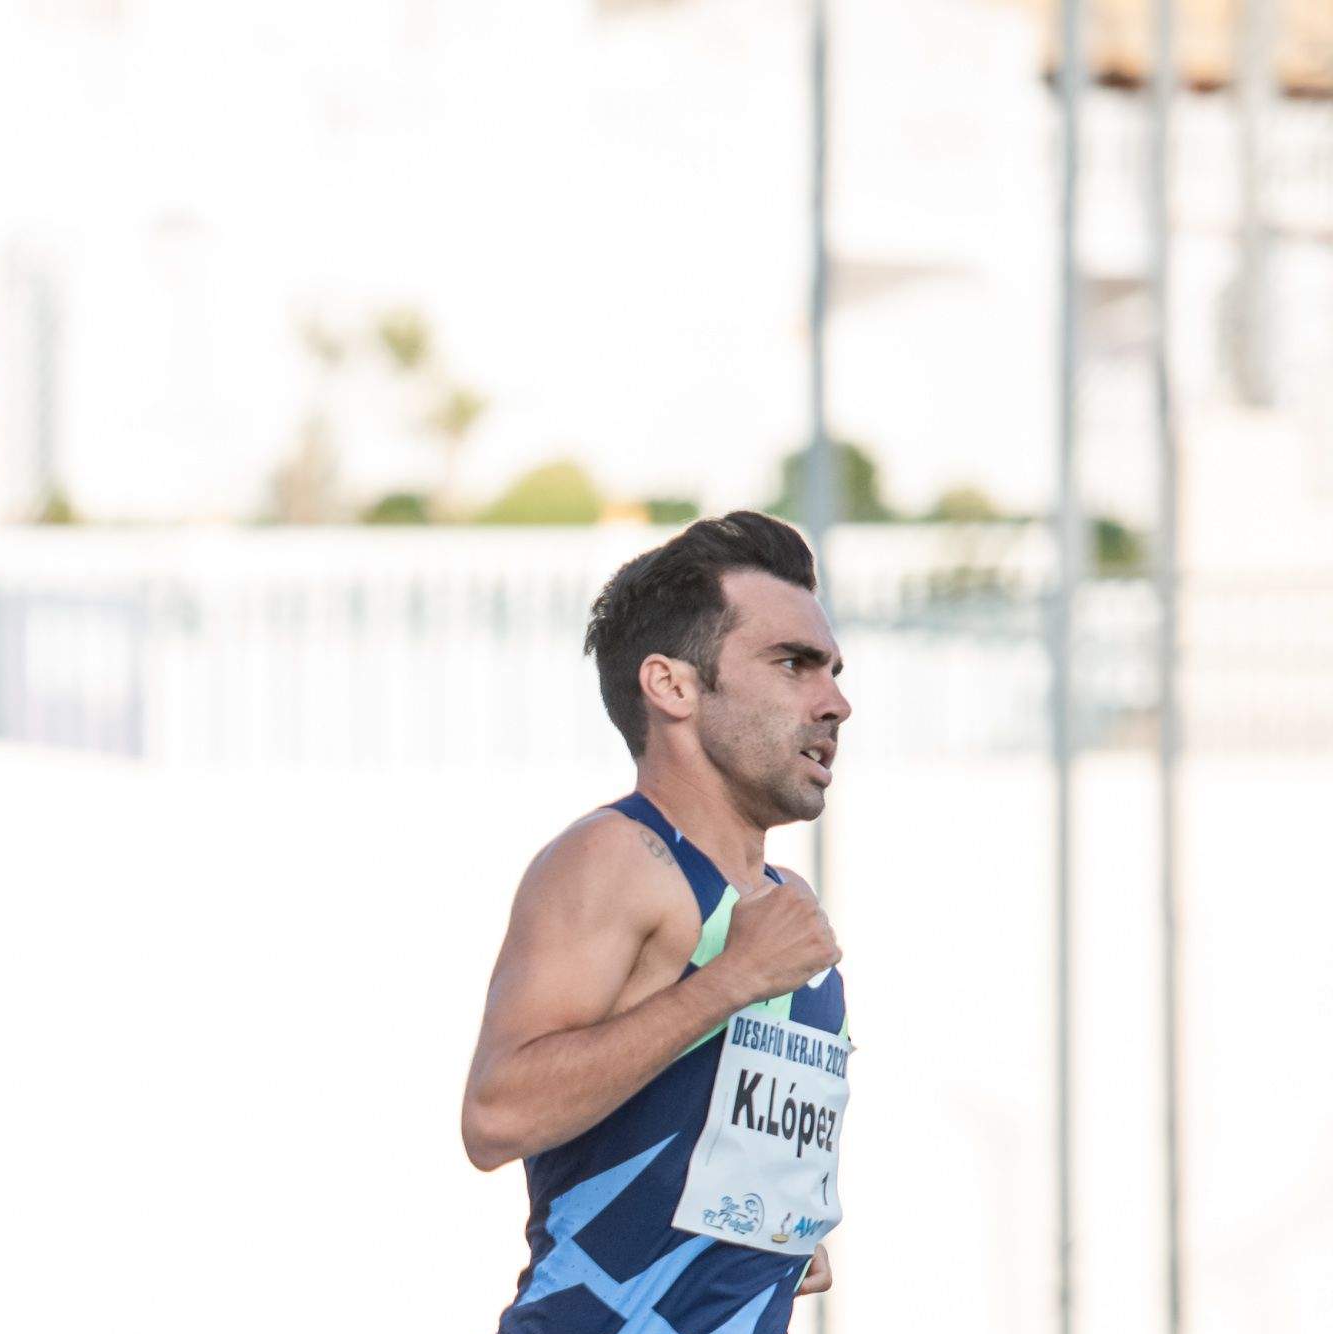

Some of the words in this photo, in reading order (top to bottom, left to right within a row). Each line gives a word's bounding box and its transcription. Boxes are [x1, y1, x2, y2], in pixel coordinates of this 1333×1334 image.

[731, 1016, 785, 1057] DESAFÍO
[786, 1031, 823, 1068] NERJA
[731, 1068, 837, 1158] K.López
[821, 1171, 829, 1206] 1
